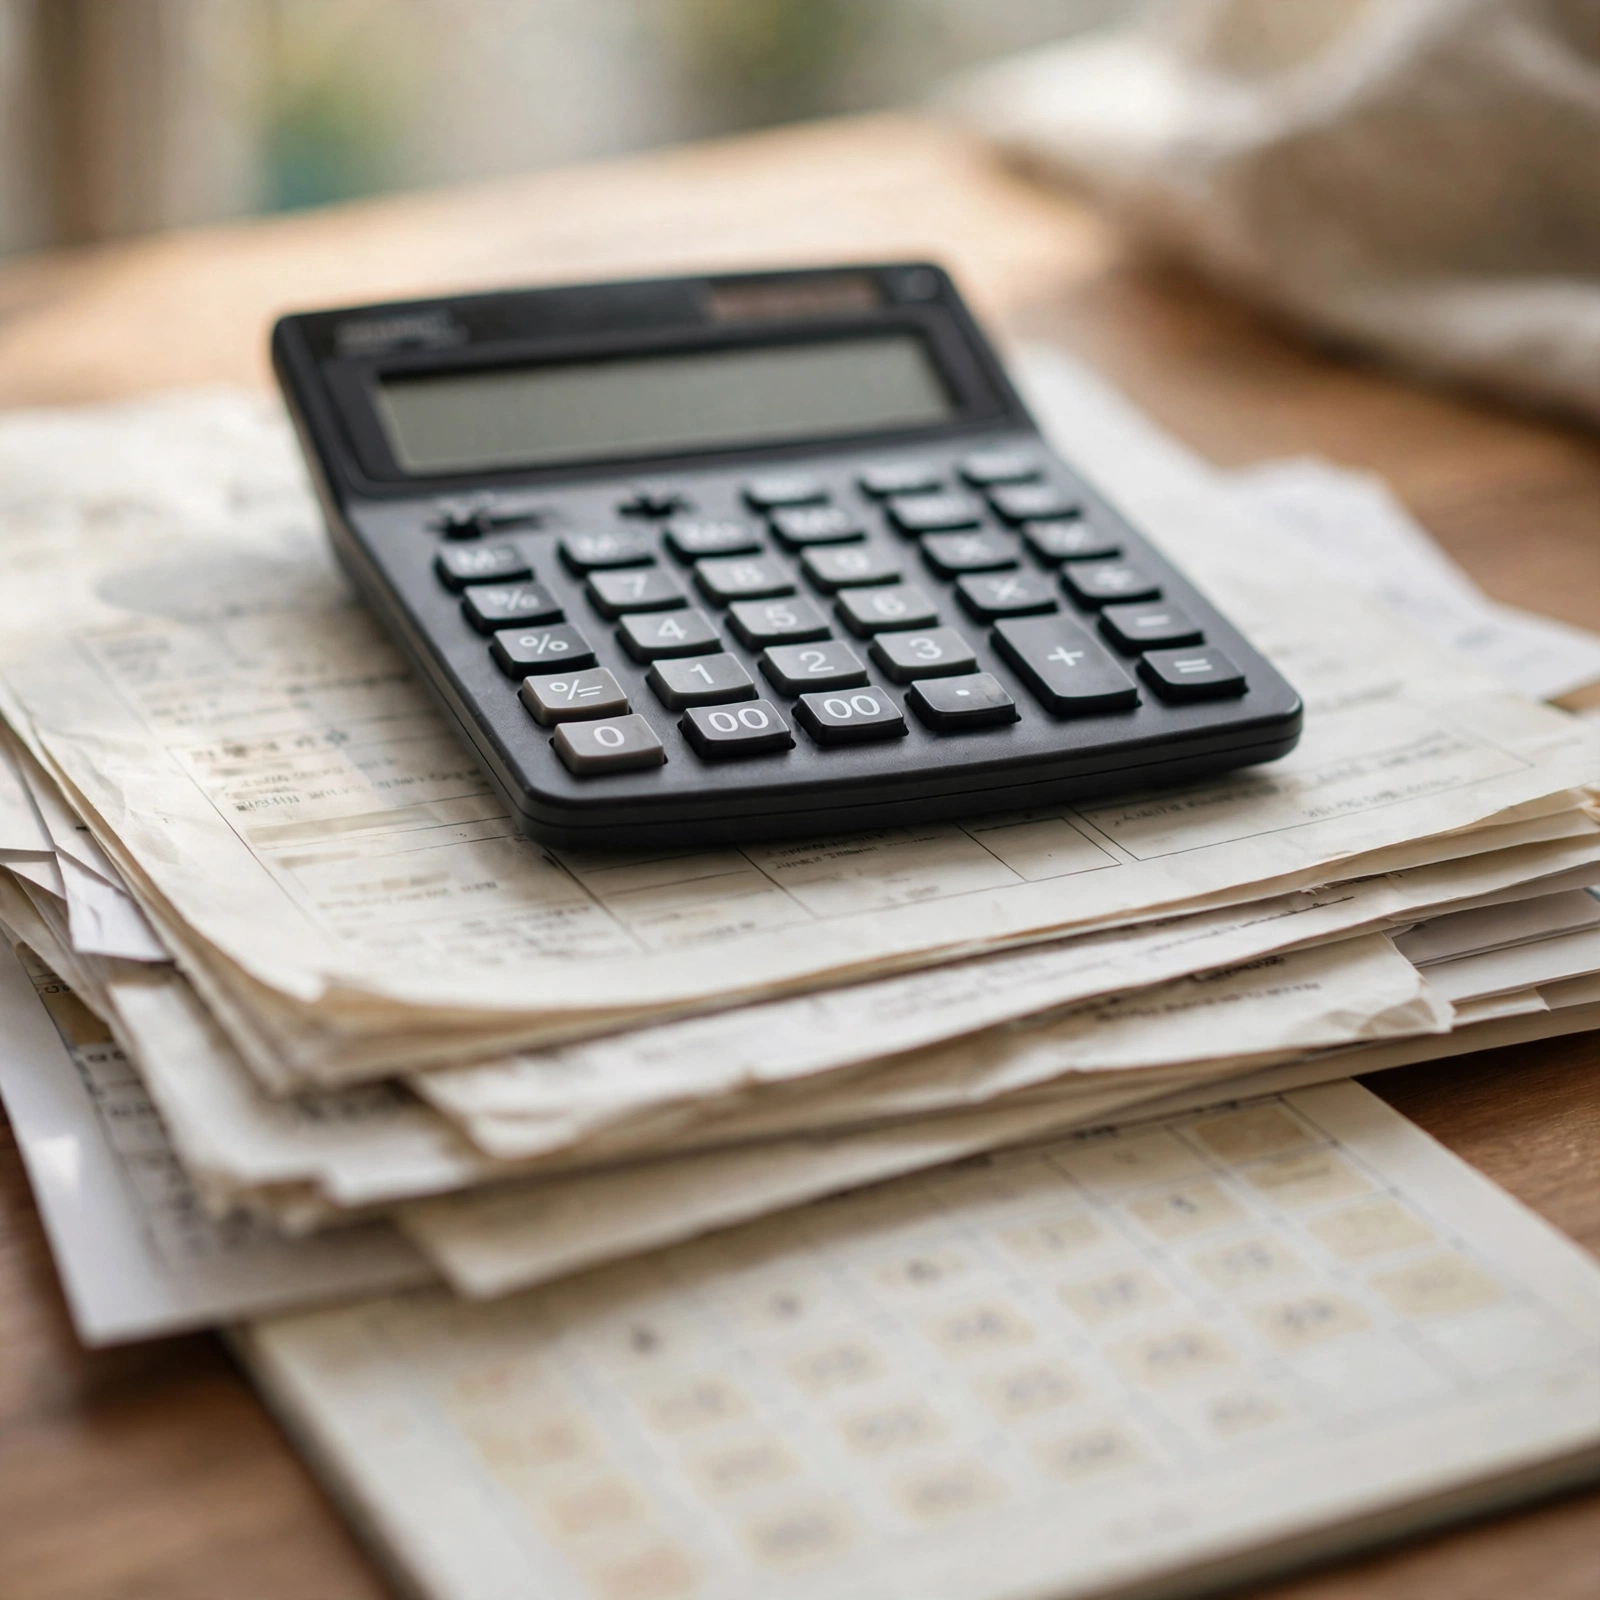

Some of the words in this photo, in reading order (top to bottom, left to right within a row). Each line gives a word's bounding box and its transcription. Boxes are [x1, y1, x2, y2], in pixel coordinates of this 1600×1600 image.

[621, 573, 649, 599] 7
[764, 603, 798, 628] 5
[872, 592, 907, 617] 6
[657, 617, 689, 641] 4
[518, 632, 570, 655] %
[908, 636, 943, 660] 3
[798, 650, 836, 673] 2
[688, 662, 716, 686] 1
[822, 693, 882, 720] 00
[707, 706, 770, 734] 00
[592, 725, 626, 748] 0
